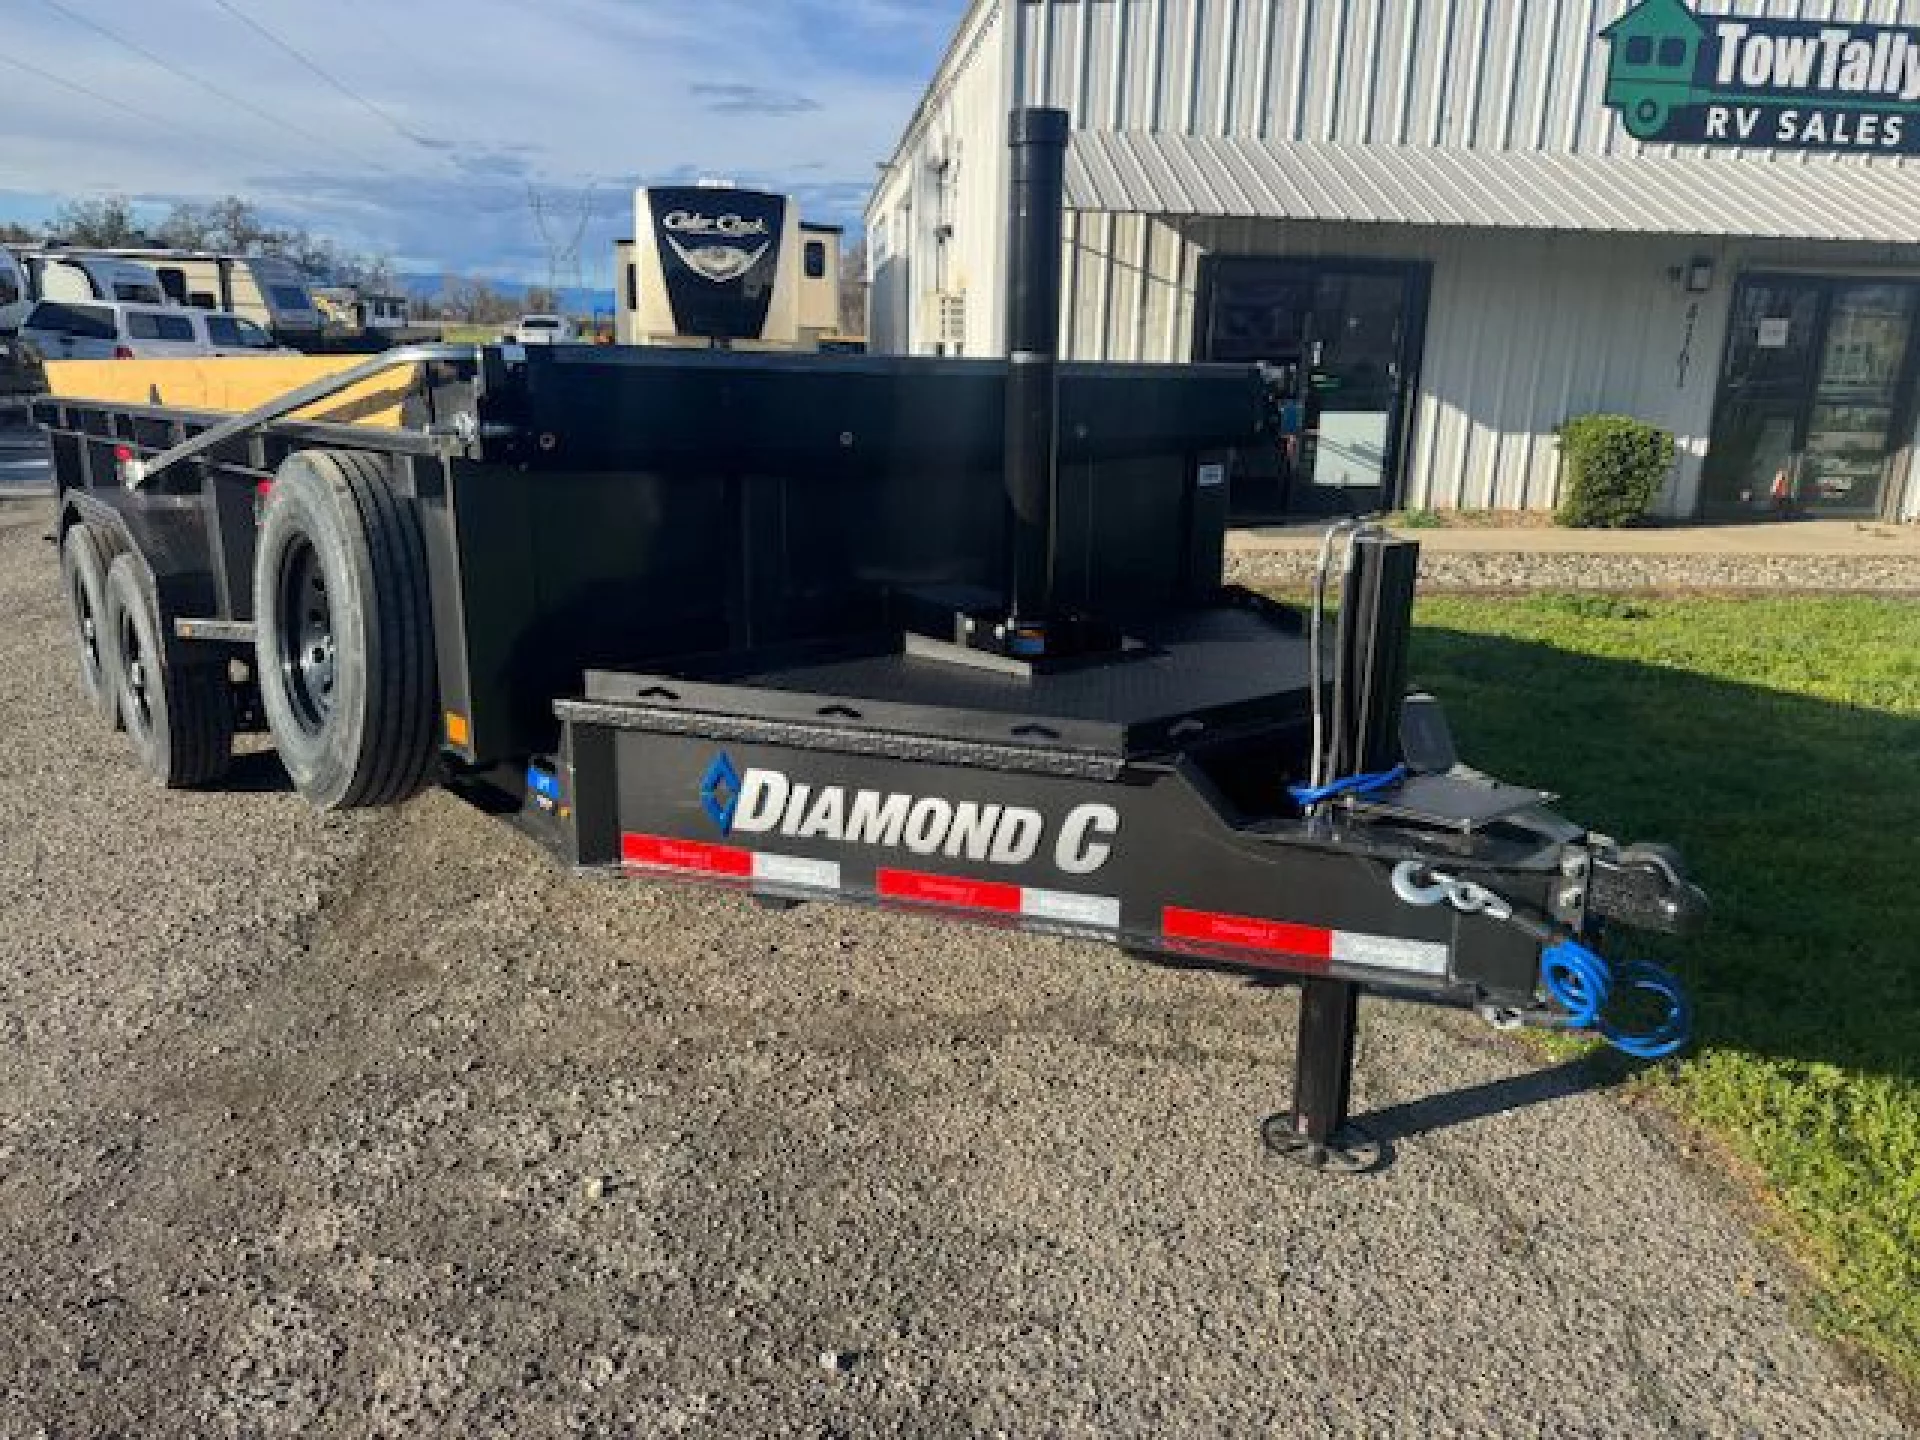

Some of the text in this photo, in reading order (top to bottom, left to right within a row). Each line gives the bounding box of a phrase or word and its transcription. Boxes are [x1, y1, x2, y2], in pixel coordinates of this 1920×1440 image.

[1705, 106, 1905, 147] RV SALES
[732, 767, 1120, 875] DIAMOND C
